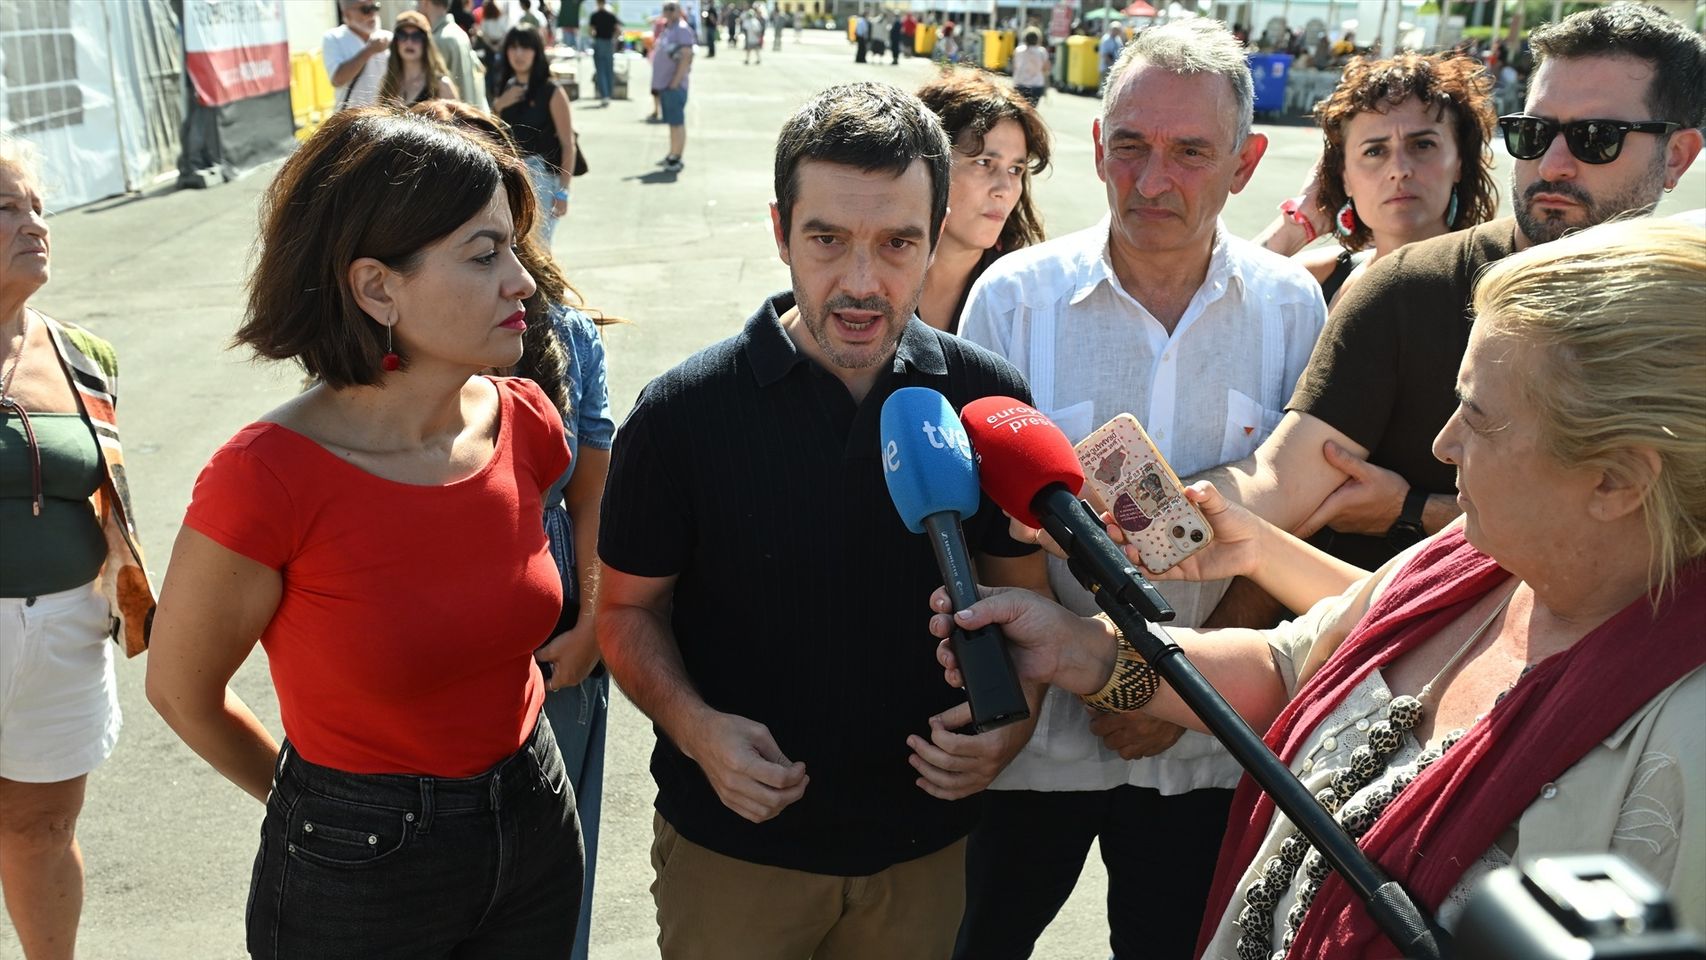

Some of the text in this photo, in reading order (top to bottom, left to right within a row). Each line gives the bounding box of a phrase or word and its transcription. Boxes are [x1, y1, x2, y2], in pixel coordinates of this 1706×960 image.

[922, 421, 972, 460] tve
[1090, 432, 1117, 455] DRAMATIC
[1114, 481, 1125, 490] over
